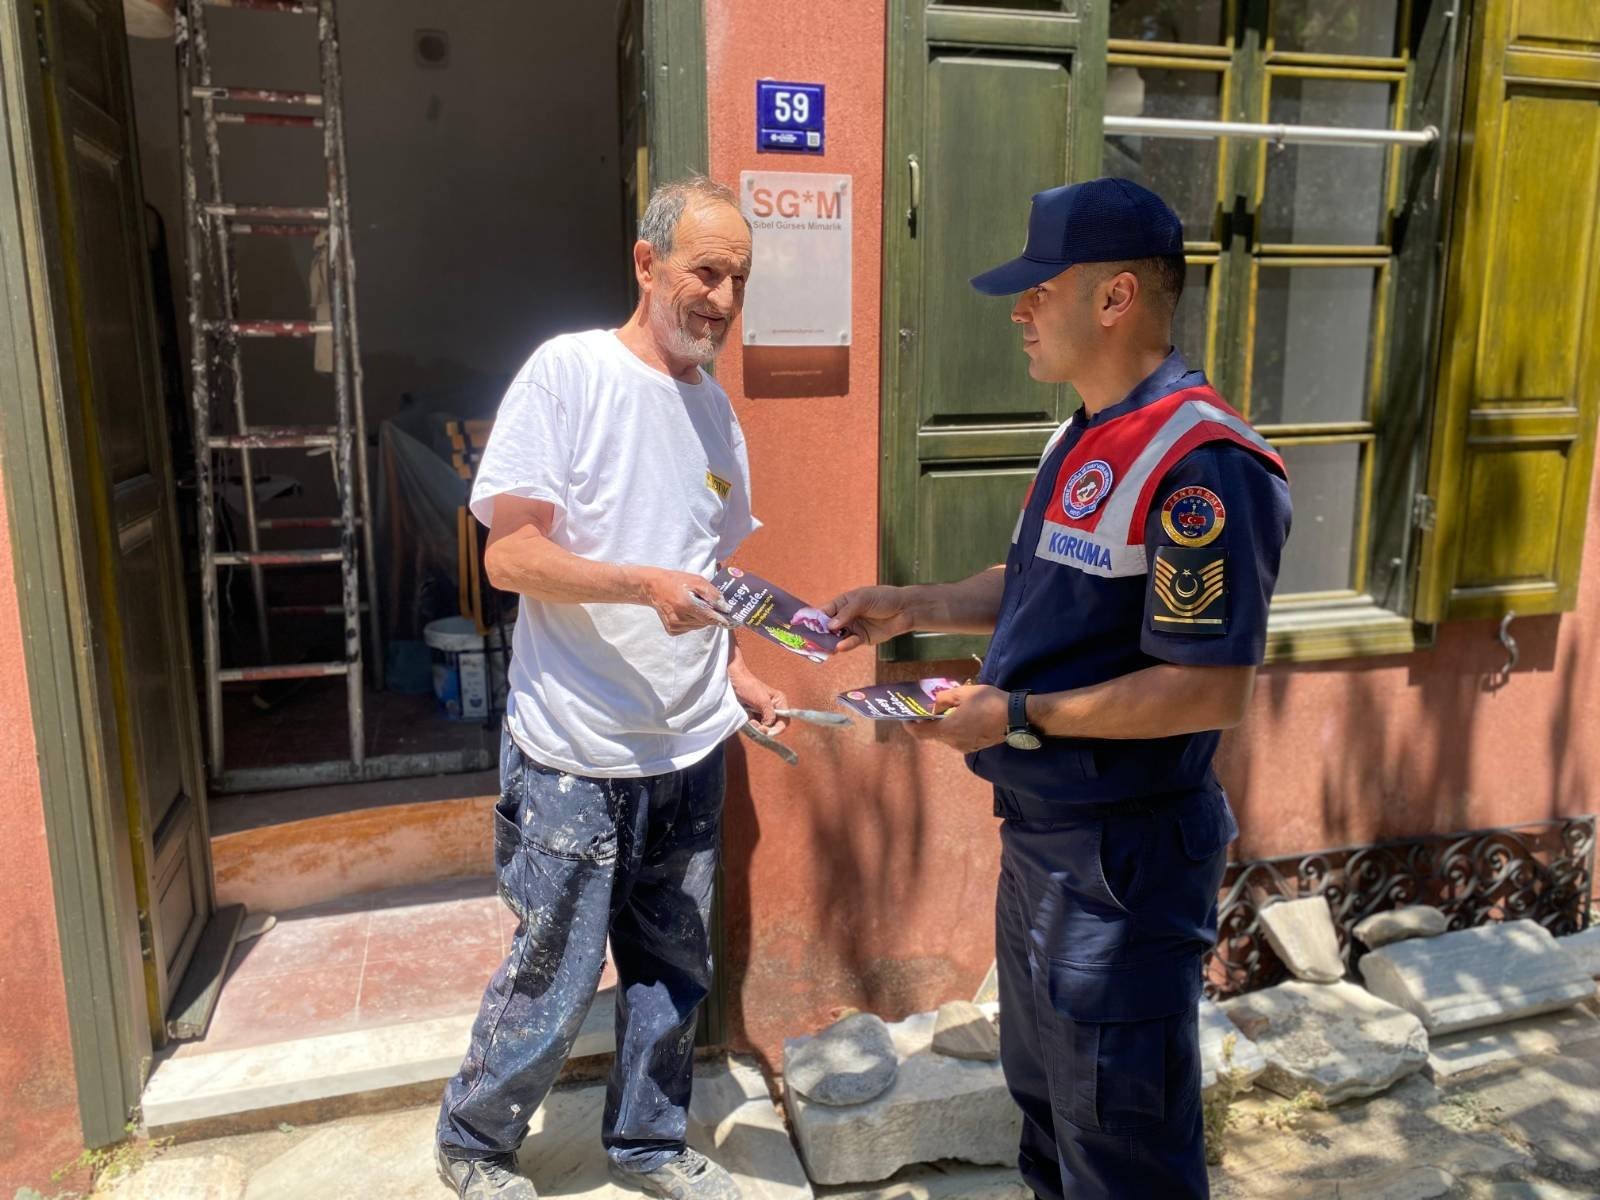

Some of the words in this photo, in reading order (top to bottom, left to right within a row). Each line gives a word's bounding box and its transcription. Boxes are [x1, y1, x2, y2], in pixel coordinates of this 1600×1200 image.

[775, 91, 809, 123] 59
[753, 221, 774, 229] Sibel
[776, 221, 805, 230] Gürses
[1168, 488, 1222, 512] JANDARMA
[1050, 532, 1113, 571] KORUMA
